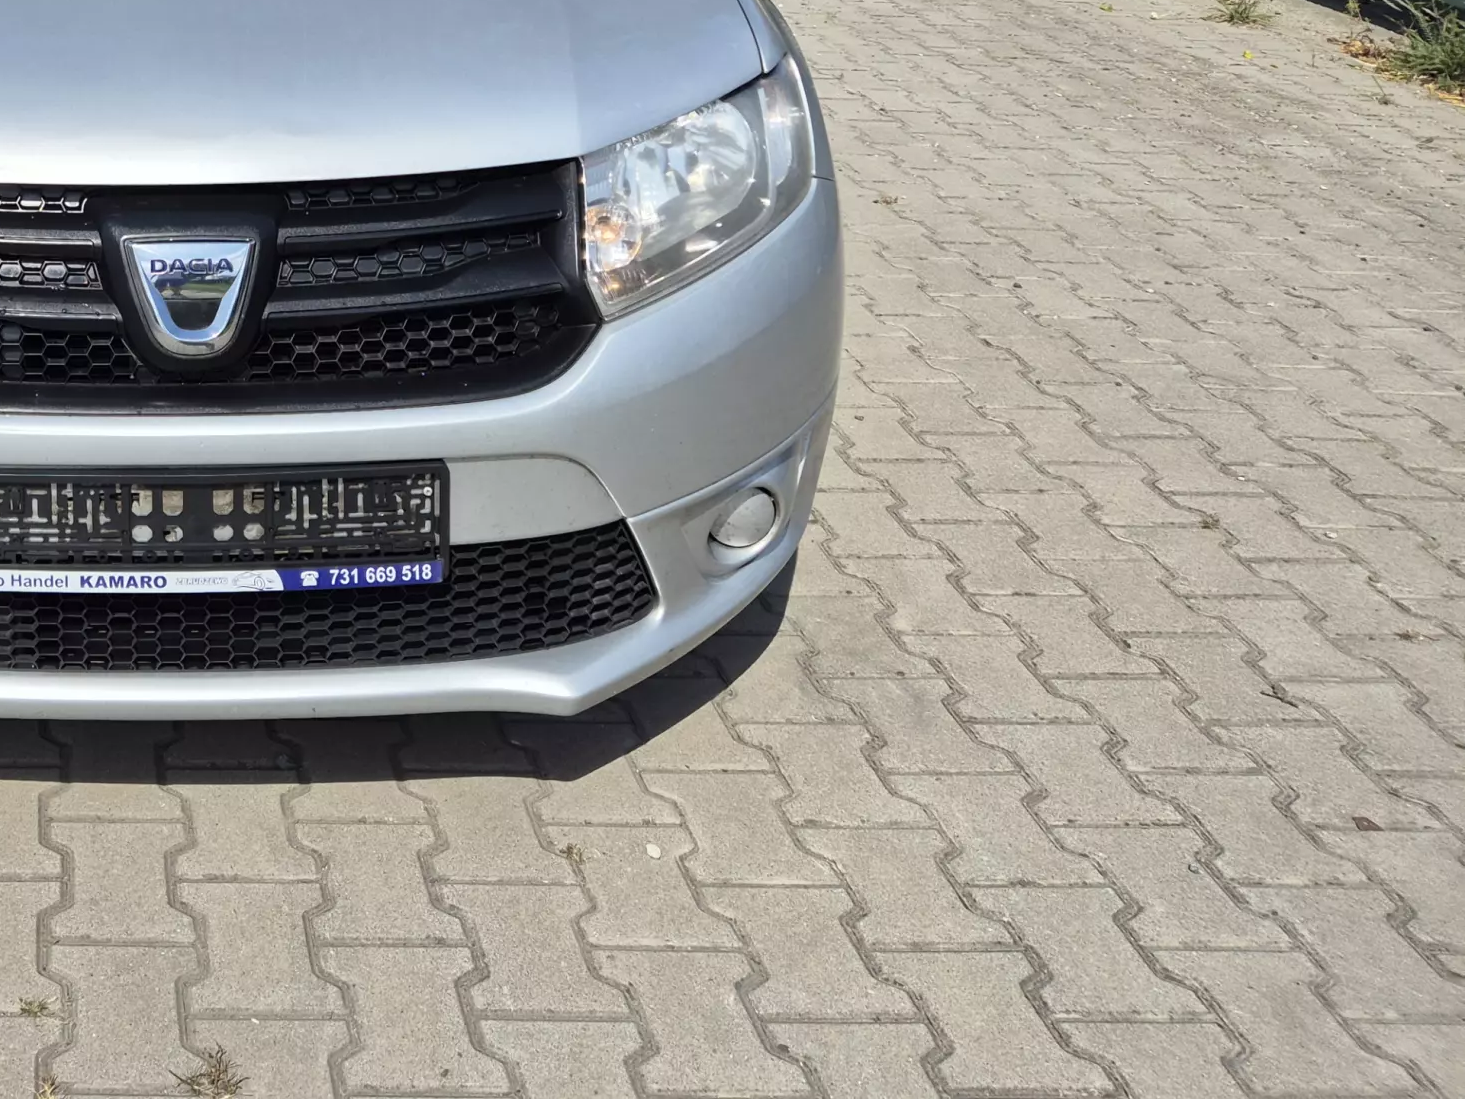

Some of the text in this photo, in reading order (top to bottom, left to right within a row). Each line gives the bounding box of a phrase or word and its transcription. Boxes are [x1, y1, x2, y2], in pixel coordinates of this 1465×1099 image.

[150, 258, 233, 273] DACIA
[10, 573, 69, 588] Handel
[79, 574, 168, 589] KAMARO
[329, 568, 359, 585] 731
[365, 566, 396, 583] 669
[401, 564, 432, 581] 518
